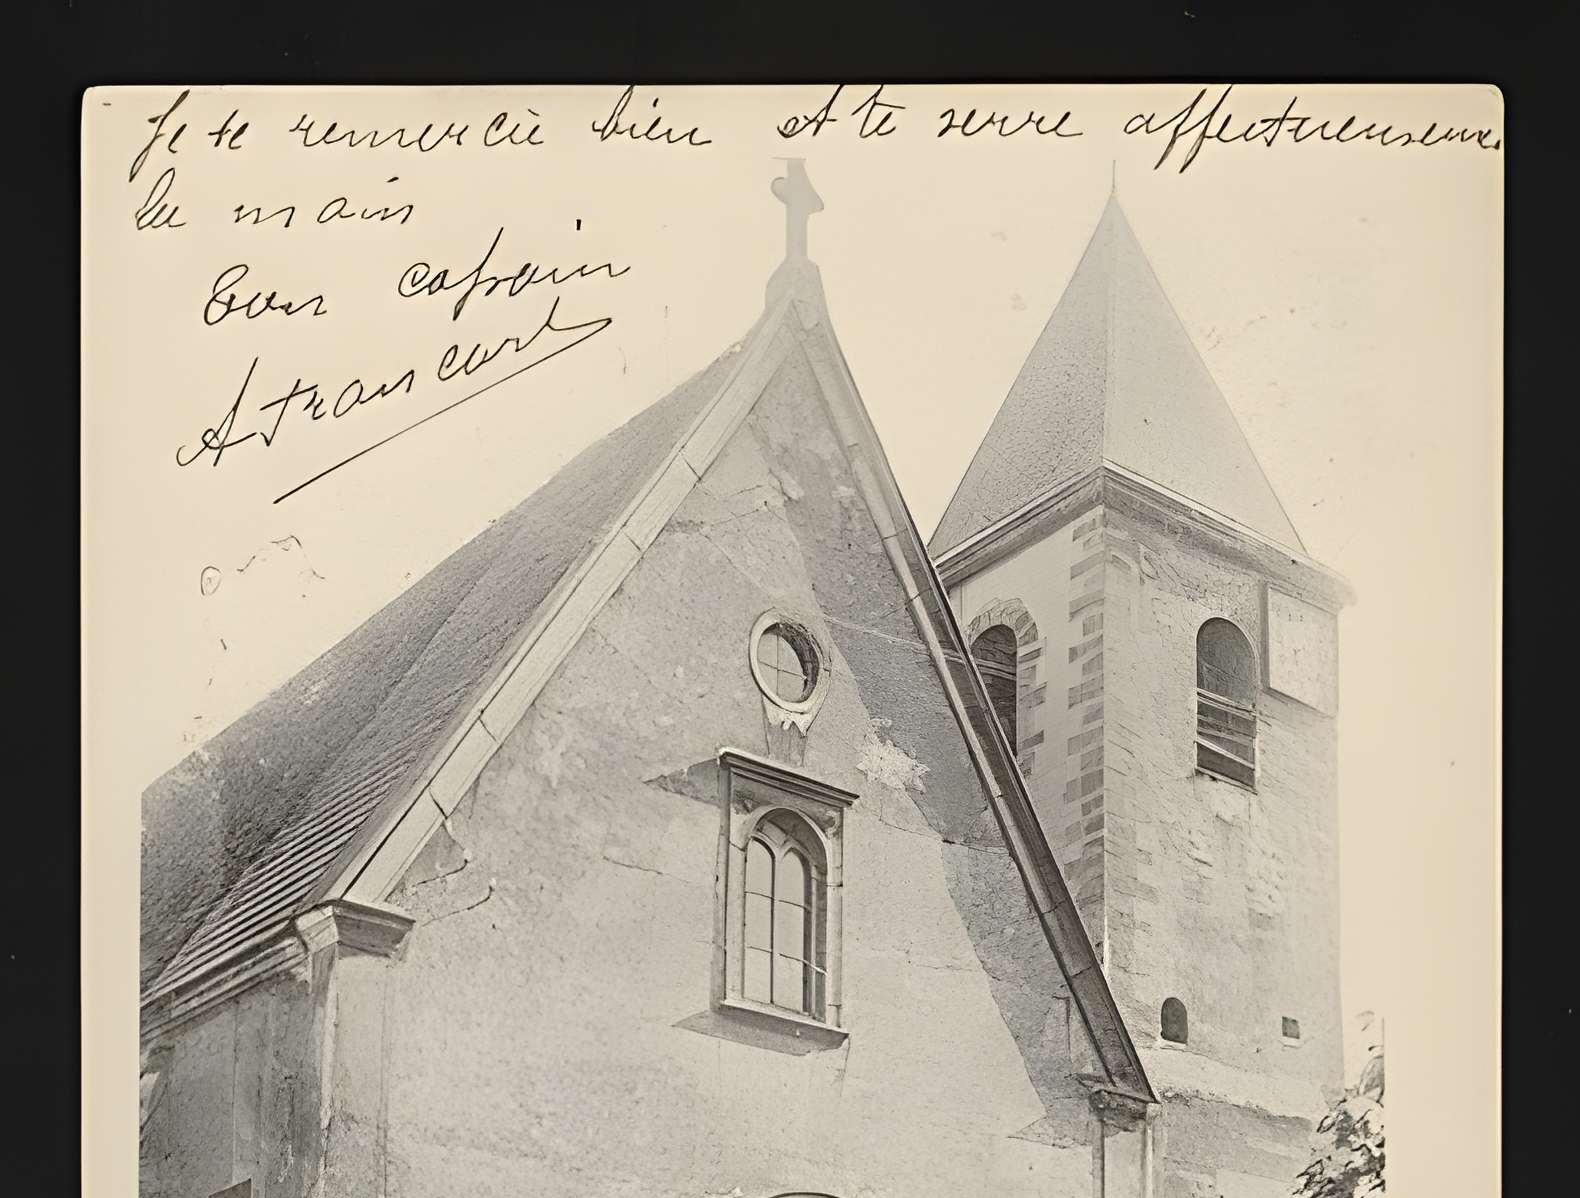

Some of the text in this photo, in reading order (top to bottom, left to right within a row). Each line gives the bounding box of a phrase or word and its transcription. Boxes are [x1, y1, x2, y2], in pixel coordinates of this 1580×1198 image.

[208, 109, 249, 149] te
[593, 85, 713, 146] bien
[852, 84, 905, 138] te
[937, 108, 1084, 138] serre
[233, 176, 414, 229] main
[397, 218, 631, 322] copain
